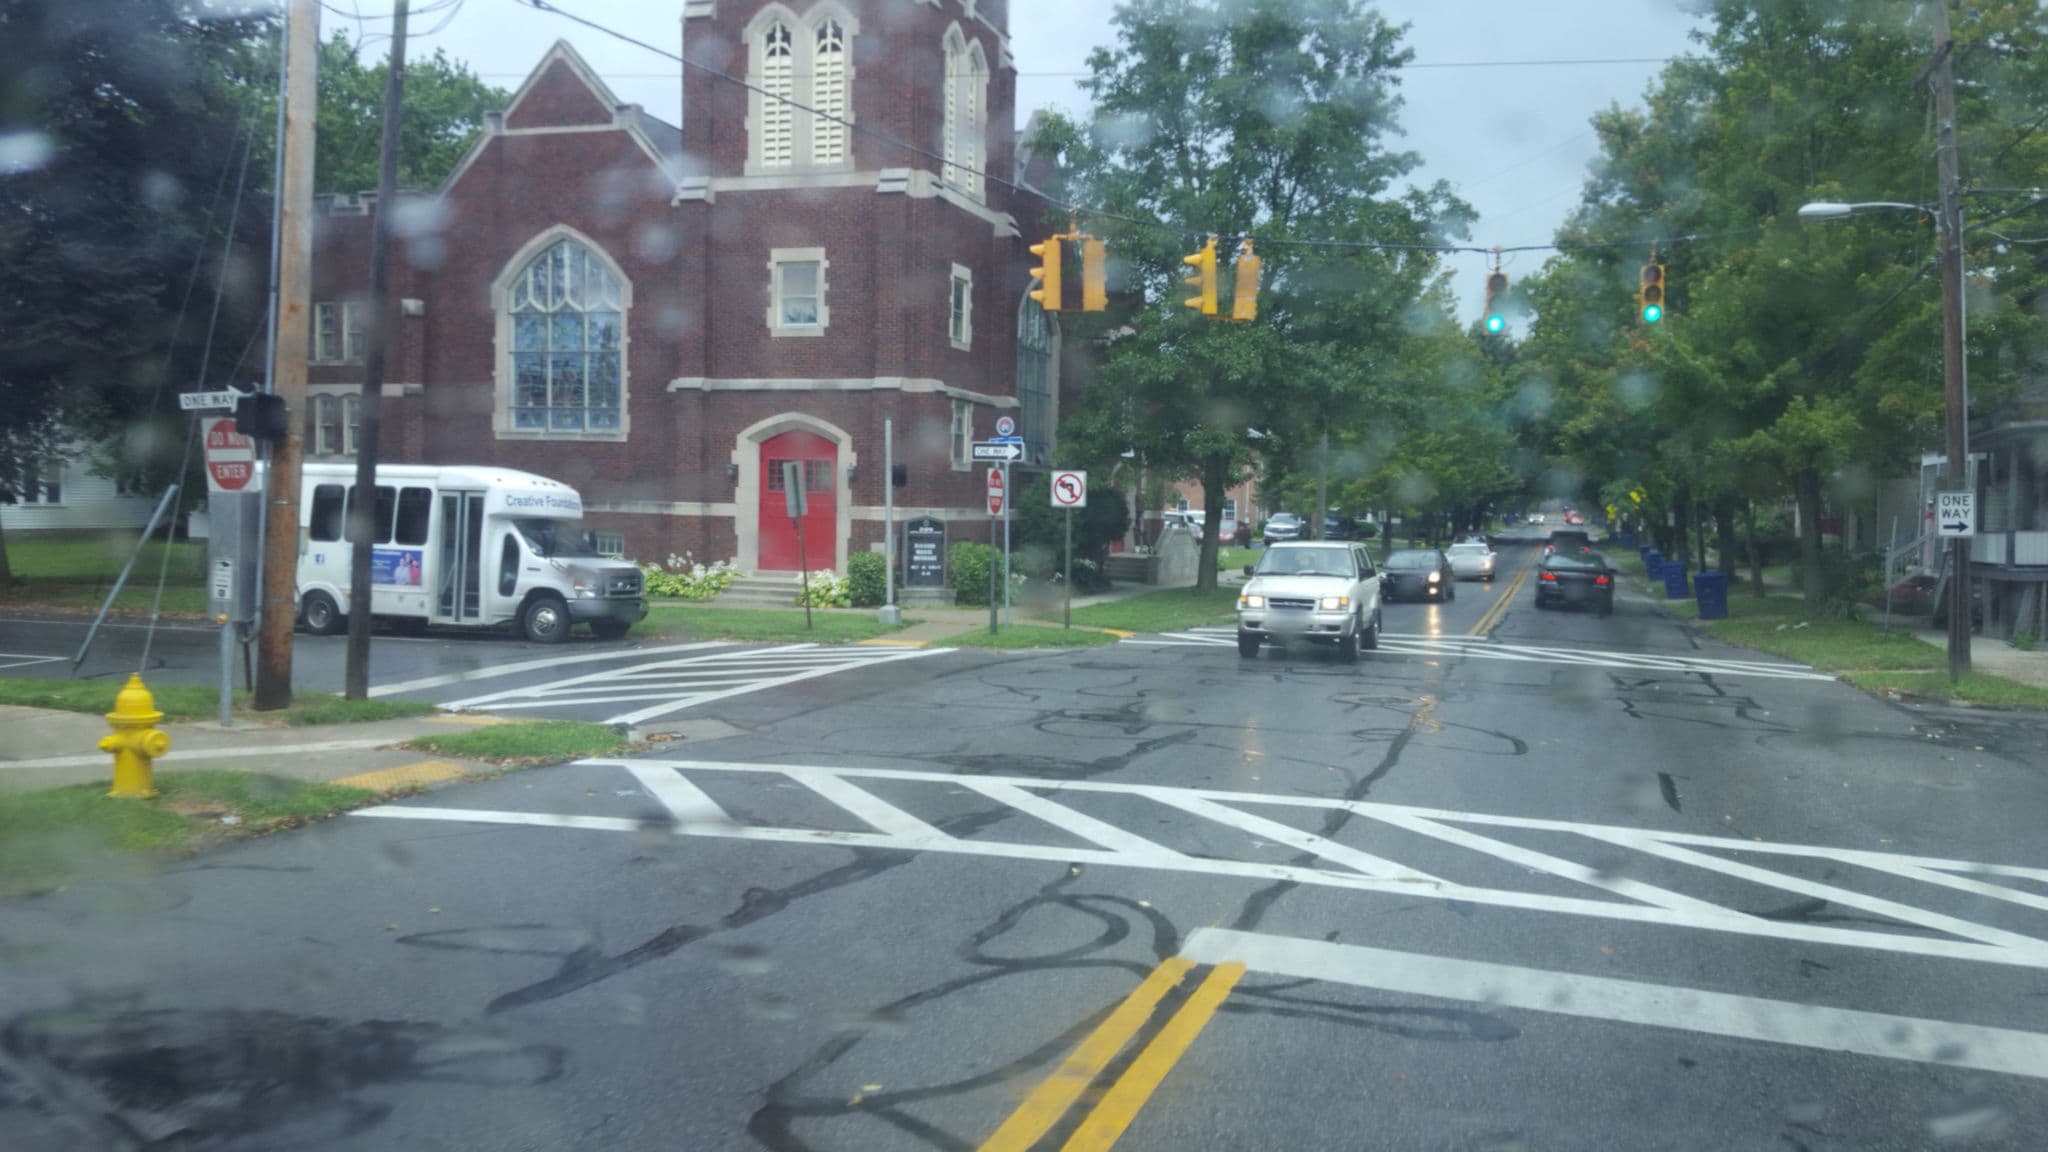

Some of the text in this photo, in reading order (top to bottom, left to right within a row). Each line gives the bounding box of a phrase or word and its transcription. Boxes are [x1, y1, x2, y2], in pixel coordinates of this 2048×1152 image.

[183, 393, 235, 407] ONE WAY
[210, 432, 225, 446] DO
[217, 464, 246, 480] ENTER
[505, 495, 544, 506] Creative
[1942, 495, 1971, 507] ONE
[1941, 508, 1971, 519] WAY
